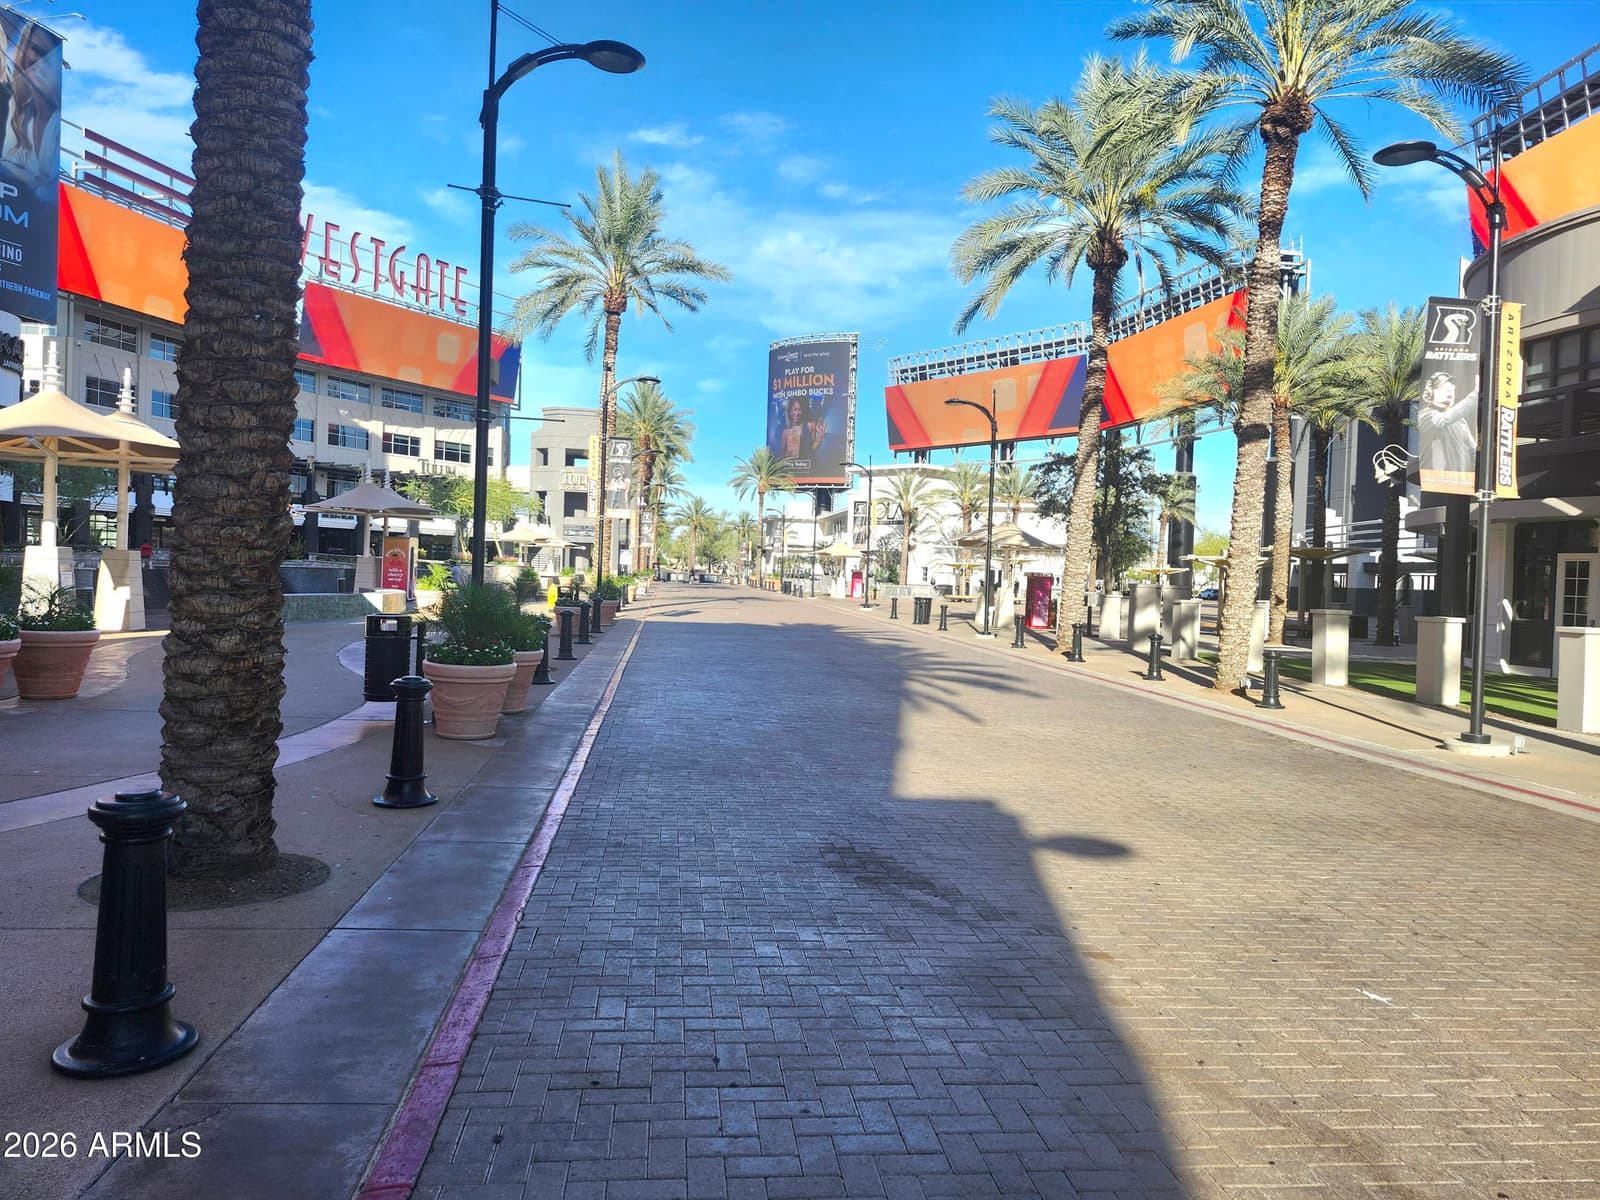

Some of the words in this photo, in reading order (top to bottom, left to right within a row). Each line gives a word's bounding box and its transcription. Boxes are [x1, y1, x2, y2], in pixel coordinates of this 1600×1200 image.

[0, 243, 23, 262] INO
[24, 286, 51, 302] PARKWAY
[1424, 351, 1478, 361] RATTLERS
[1505, 313, 1515, 398] ARIZONA
[784, 367, 800, 376] PLAY
[800, 366, 815, 374] FOR
[773, 378, 782, 391] $1
[783, 373, 835, 388] MILLION
[786, 388, 808, 399] JUMBO
[808, 387, 834, 396] BUCKS
[1499, 405, 1516, 487] RATTLERS
